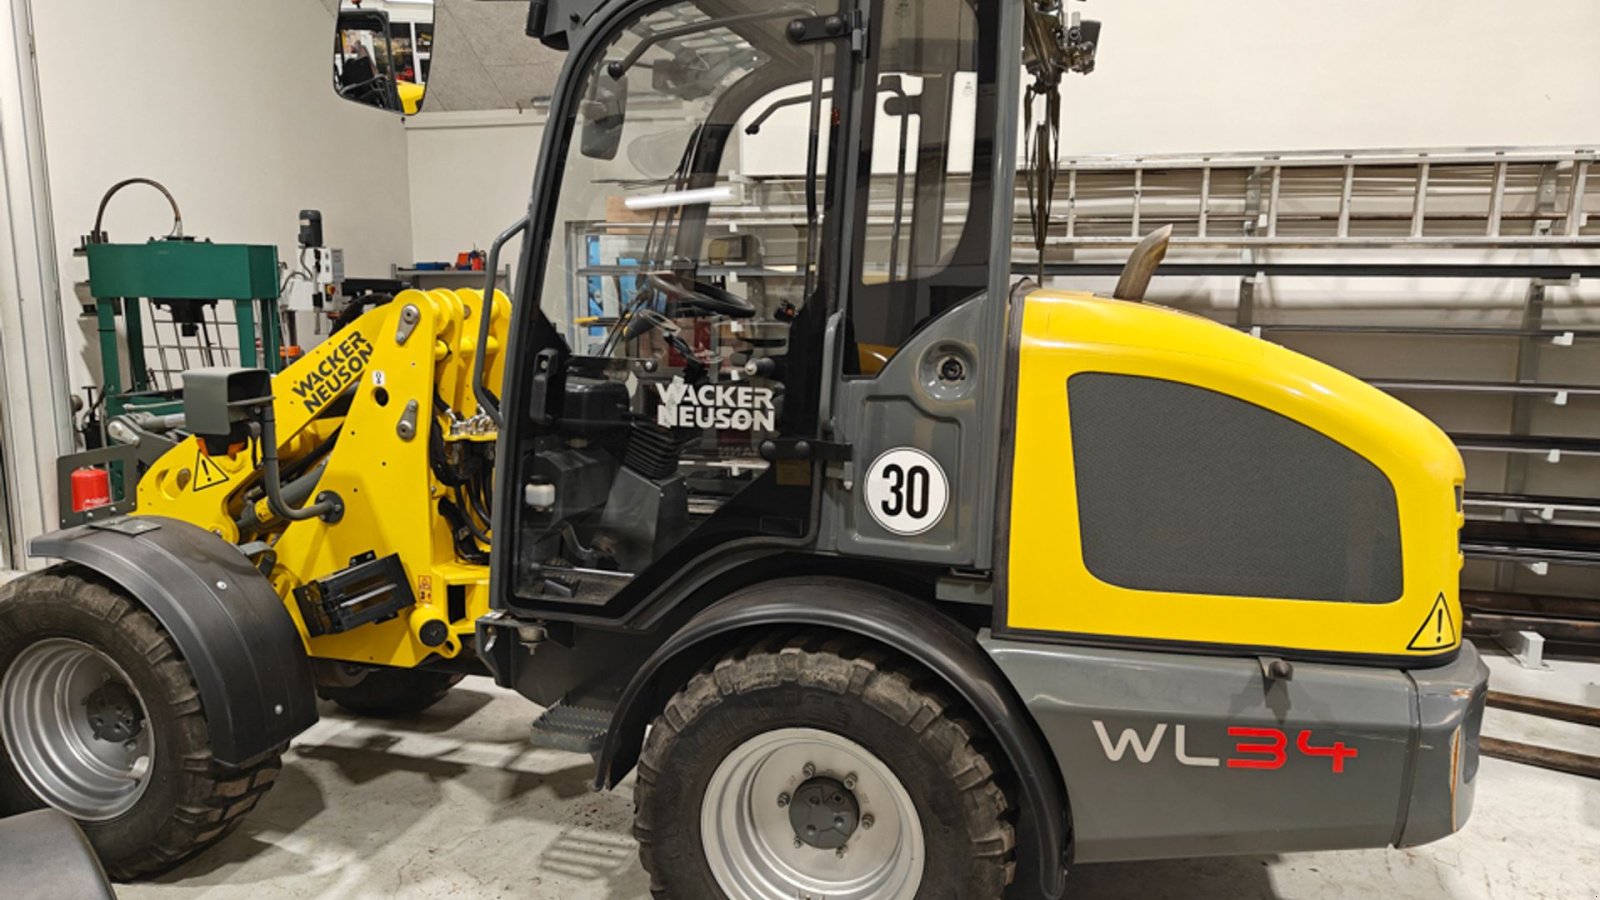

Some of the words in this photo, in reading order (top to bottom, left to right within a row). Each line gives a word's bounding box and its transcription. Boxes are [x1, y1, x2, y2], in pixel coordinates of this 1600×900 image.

[292, 331, 366, 397] WACKER
[303, 343, 374, 414] NEUSON
[655, 383, 775, 409] WACKER
[657, 405, 775, 432] NEUSON
[881, 464, 930, 519] 30
[1092, 720, 1359, 773] WL34
